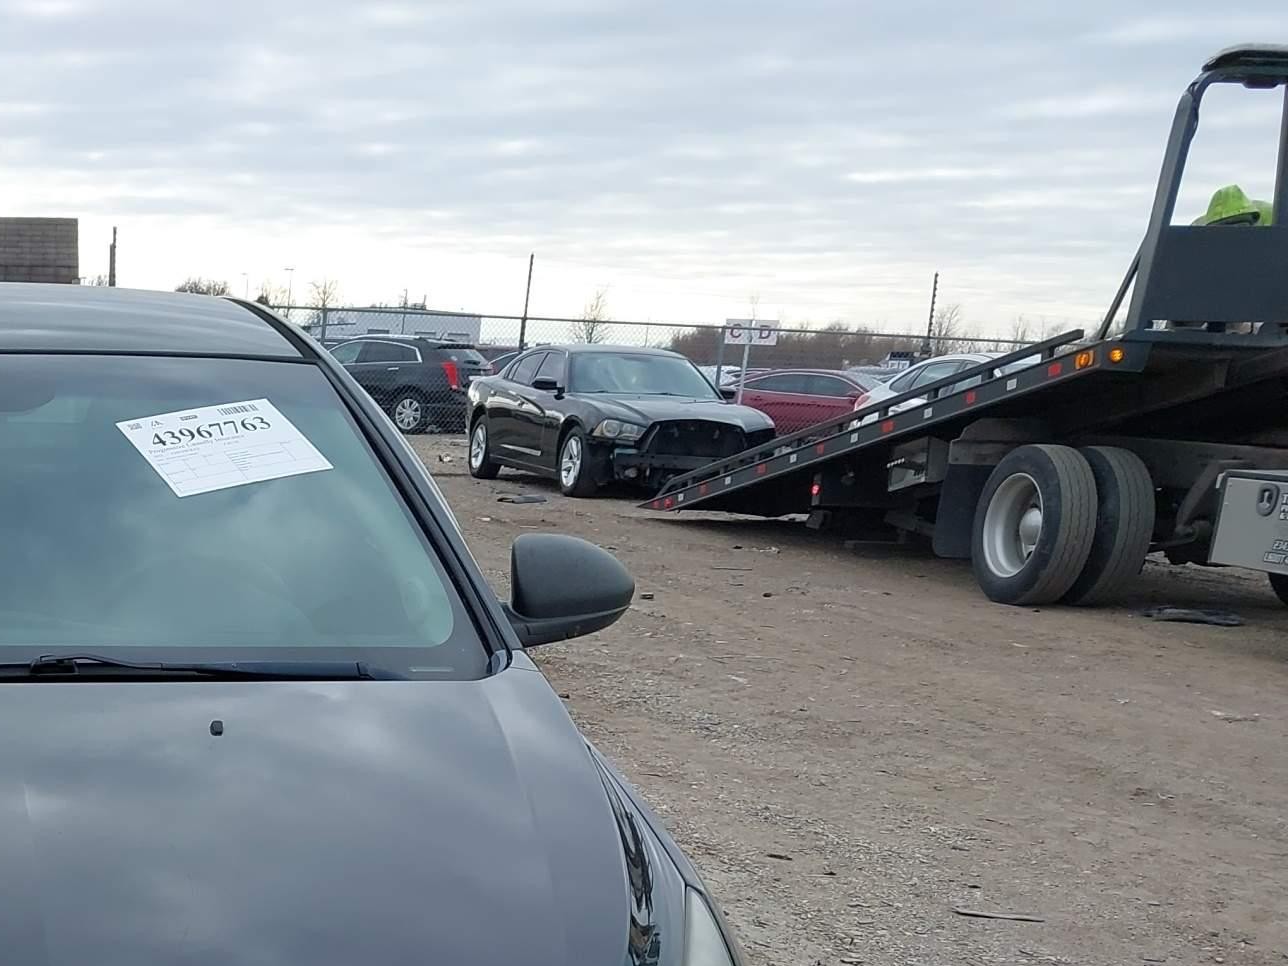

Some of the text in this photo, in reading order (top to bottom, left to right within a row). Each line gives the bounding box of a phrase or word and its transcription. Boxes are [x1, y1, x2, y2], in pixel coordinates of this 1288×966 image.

[730, 323, 772, 340] C D
[151, 415, 272, 448] 43967763
